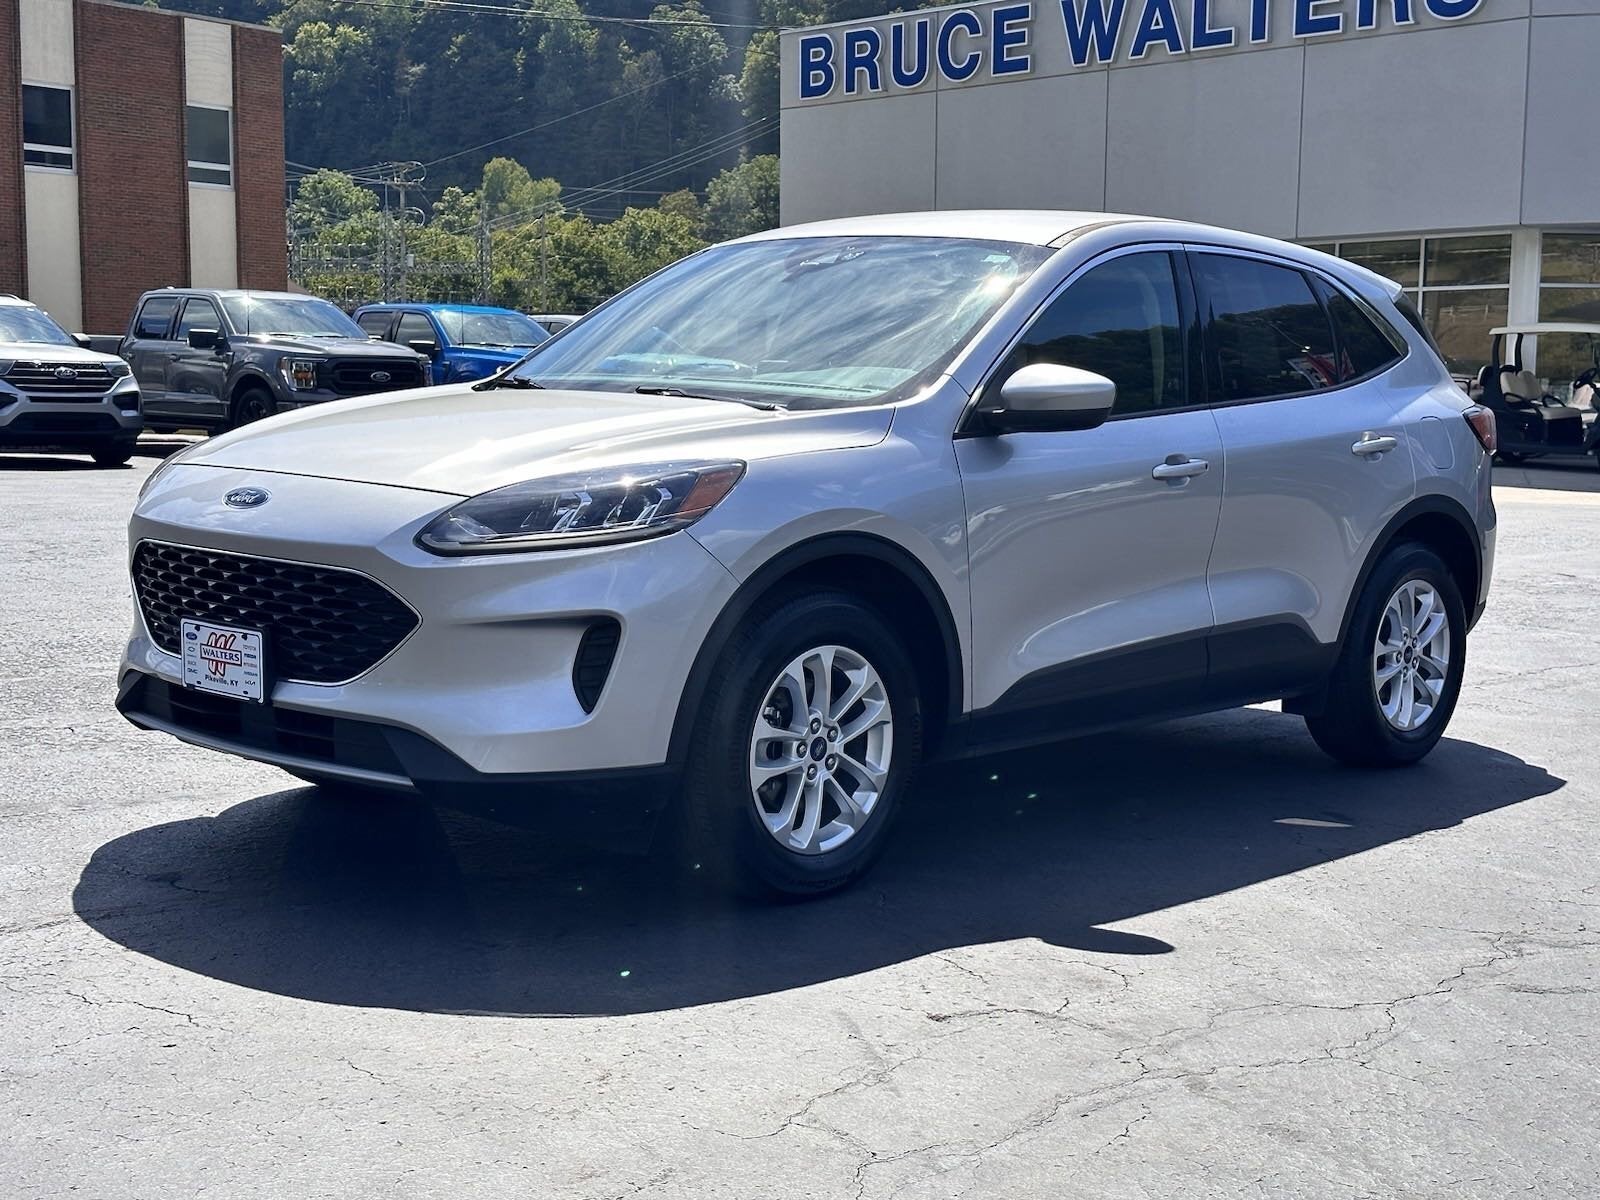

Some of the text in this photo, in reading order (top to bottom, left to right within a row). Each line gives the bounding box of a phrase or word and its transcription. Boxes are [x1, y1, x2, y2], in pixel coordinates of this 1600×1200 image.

[800, 0, 1482, 100] BRUCE WALTE
[202, 647, 240, 662] WALTERS
[230, 679, 239, 687] KY
